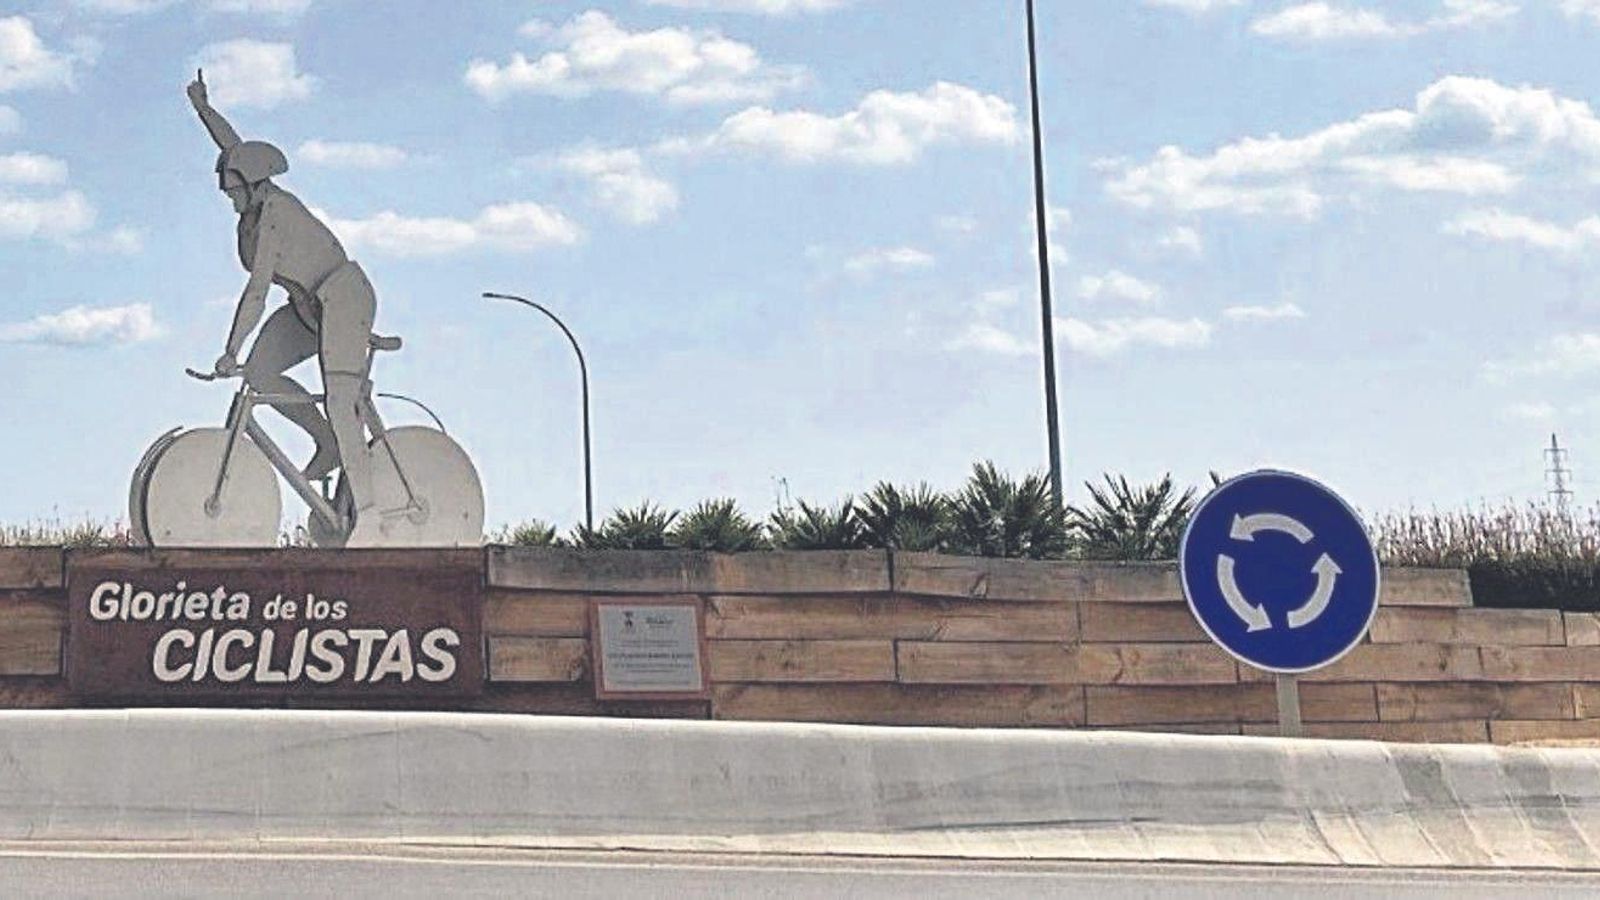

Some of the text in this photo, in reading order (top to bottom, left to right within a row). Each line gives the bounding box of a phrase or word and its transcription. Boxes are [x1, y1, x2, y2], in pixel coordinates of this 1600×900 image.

[89, 581, 349, 622] Glorieta de los
[152, 628, 461, 683] CICLISTAS
